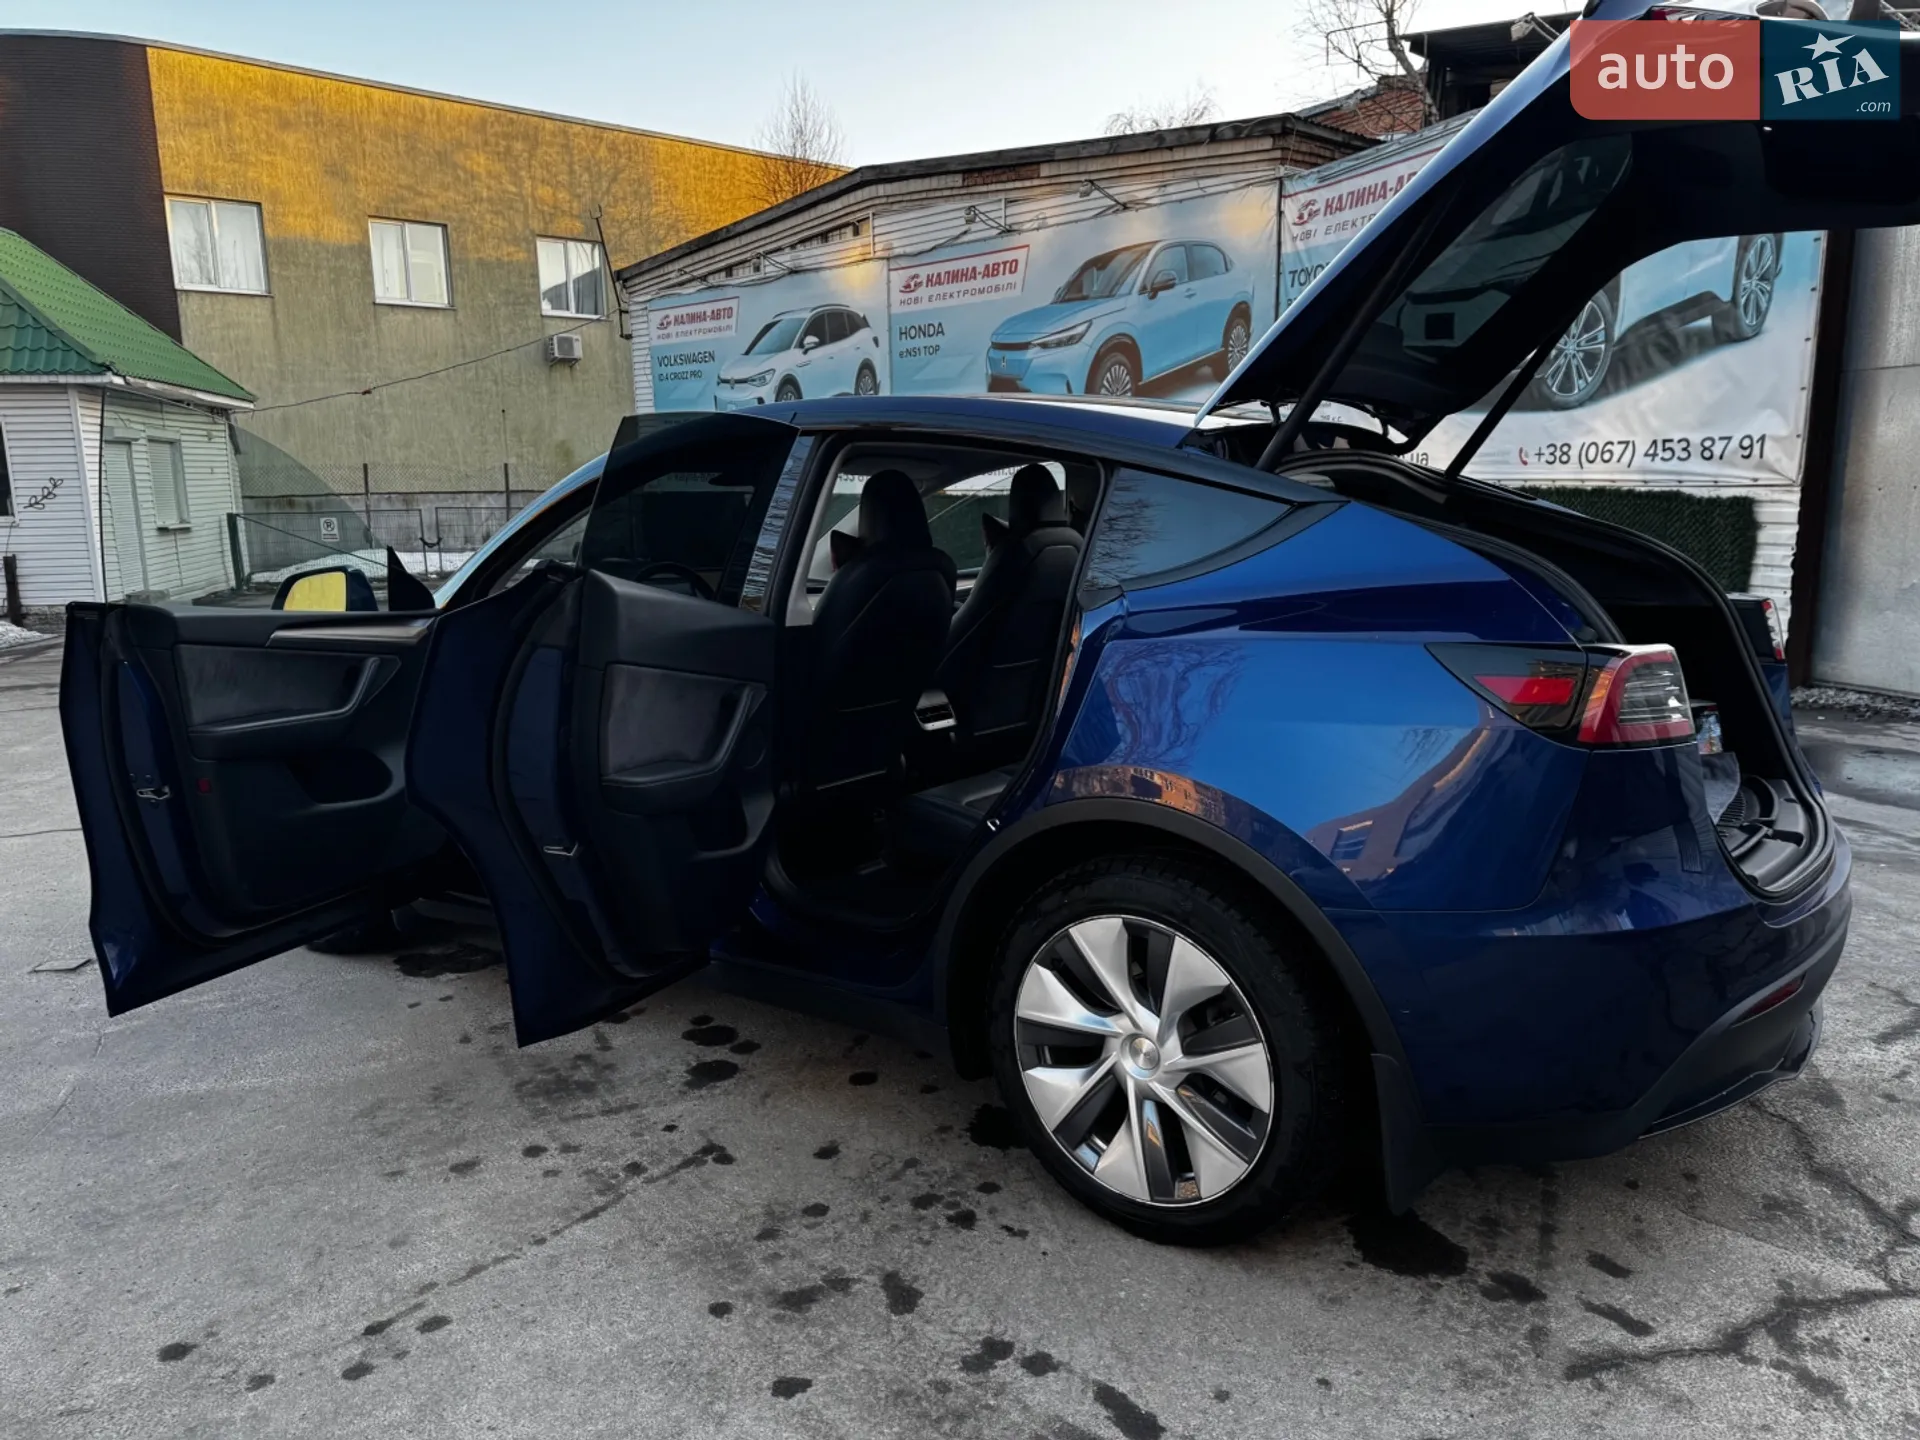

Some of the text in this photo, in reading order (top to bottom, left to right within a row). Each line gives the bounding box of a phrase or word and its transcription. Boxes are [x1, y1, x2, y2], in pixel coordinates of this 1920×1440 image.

[925, 259, 1019, 288] КАЛИНА-АВТО
[1288, 261, 1332, 288] TOYO
[899, 281, 1017, 307] НОВІ ЕЛЕКТРОМОБІЛІ
[673, 306, 734, 327] КАЛИНА-АВТО
[898, 321, 945, 341] HONDA
[657, 350, 716, 368] VOLKSWAGEN
[923, 344, 941, 356] TOP
[689, 369, 703, 379] PRO
[1534, 433, 1768, 469] +38 (067) 453 87 91
